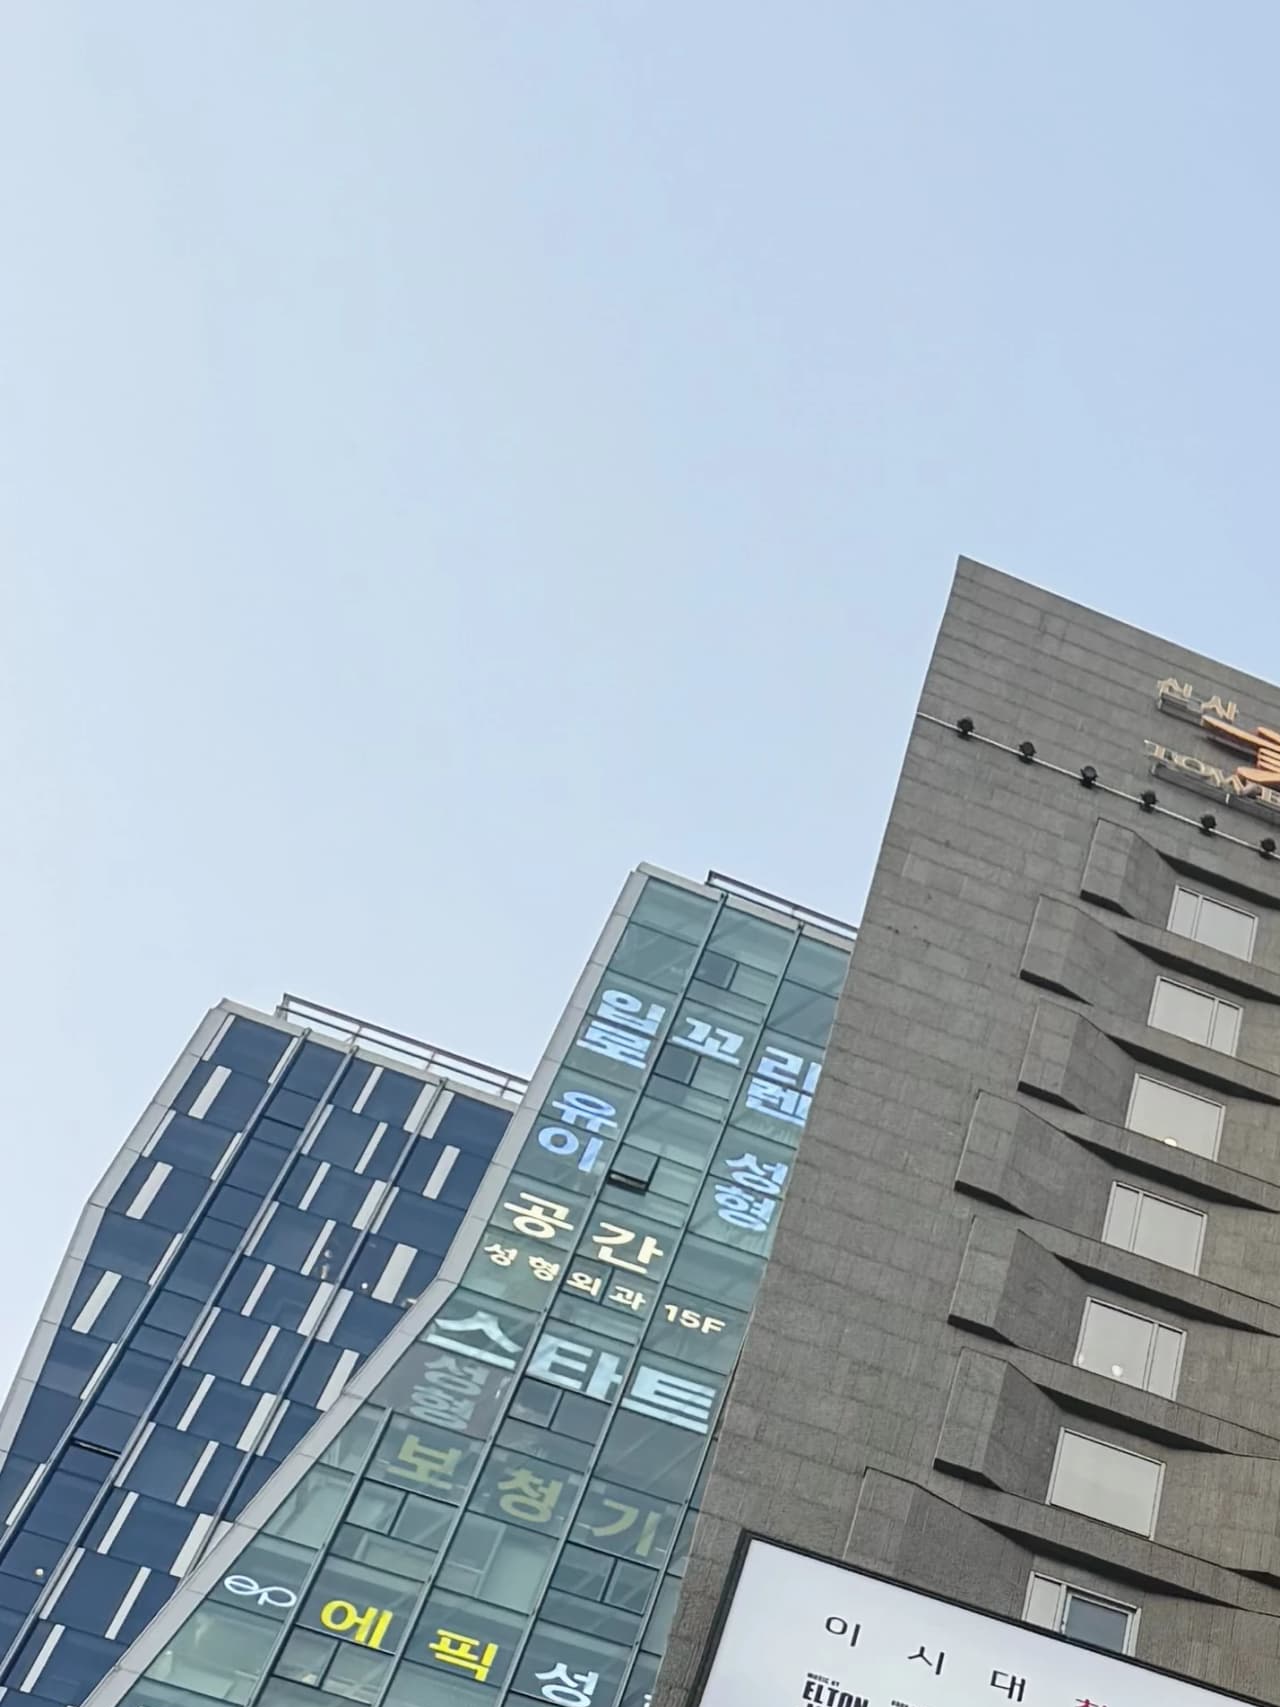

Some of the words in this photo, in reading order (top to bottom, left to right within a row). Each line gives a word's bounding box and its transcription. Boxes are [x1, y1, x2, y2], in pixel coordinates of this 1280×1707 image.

[503, 1191, 664, 1275] 공간
[484, 1243, 647, 1311] 성형외과
[664, 1303, 726, 1334] 15F
[426, 1311, 717, 1435] 스타트
[386, 1434, 661, 1558] 보청기
[824, 1615, 861, 1647] 이
[907, 1644, 1027, 1703] 시대
